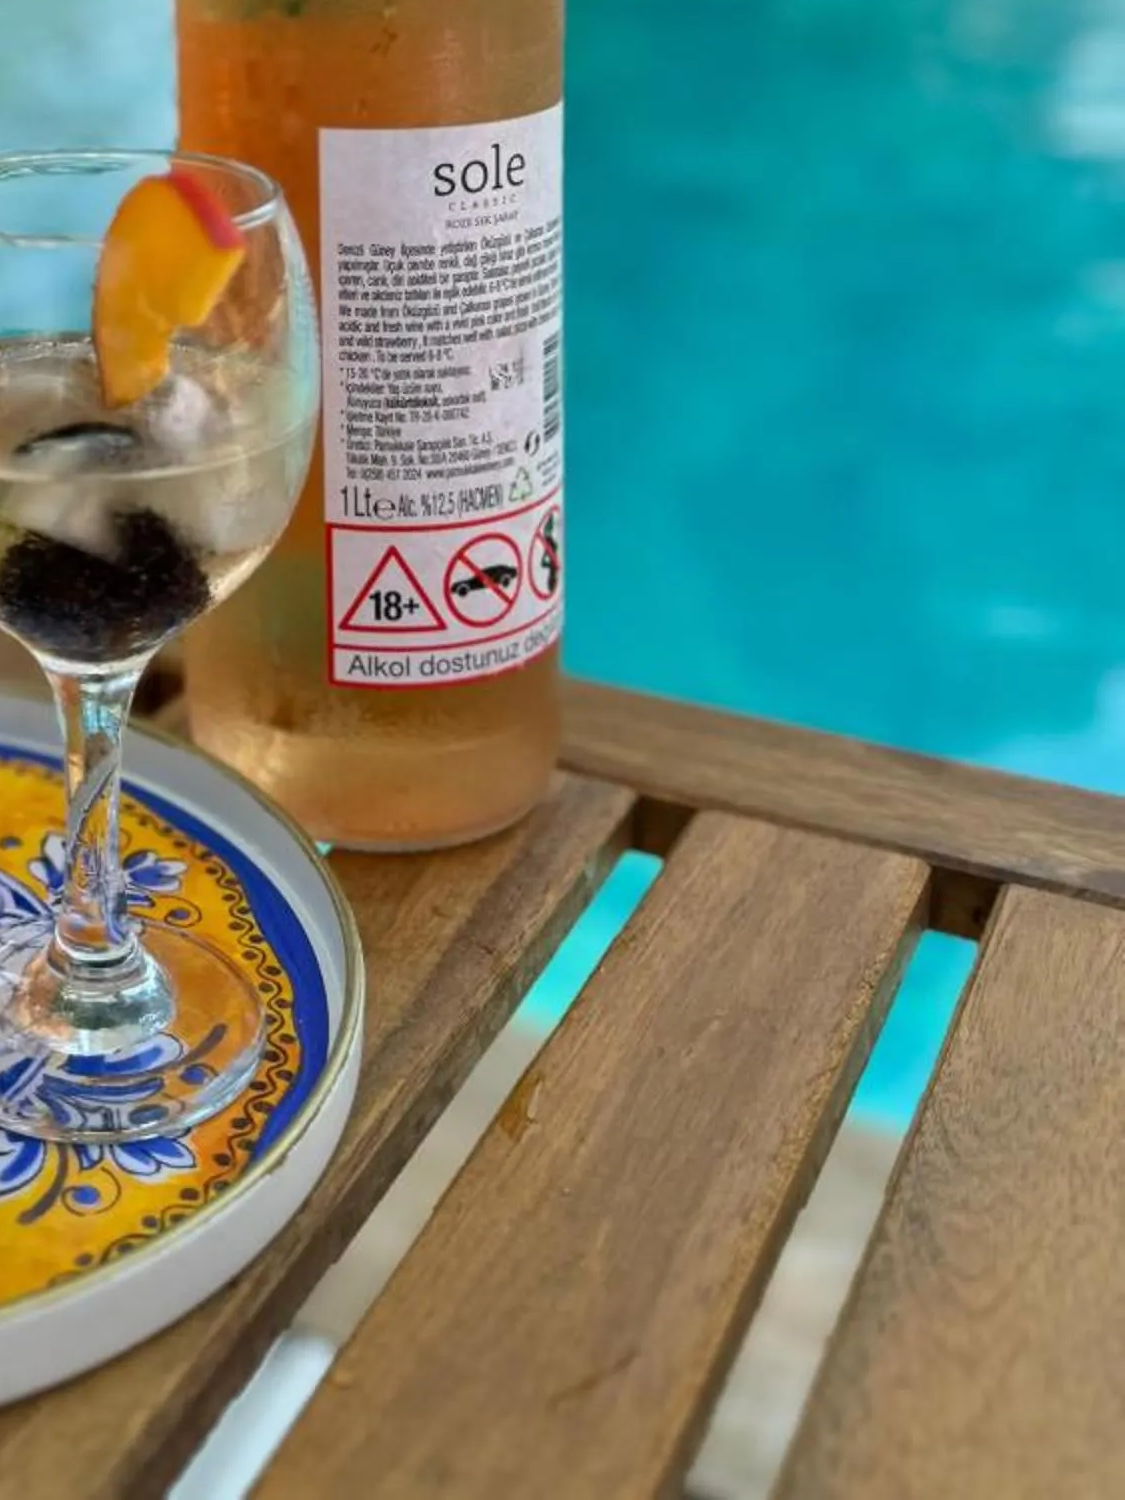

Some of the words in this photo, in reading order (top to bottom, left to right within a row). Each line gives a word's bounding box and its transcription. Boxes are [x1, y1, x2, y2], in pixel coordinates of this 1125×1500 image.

[433, 143, 526, 197] sole
[369, 590, 420, 621] 18+
[347, 654, 411, 677] Alkol
[420, 640, 521, 677] dostunuz
